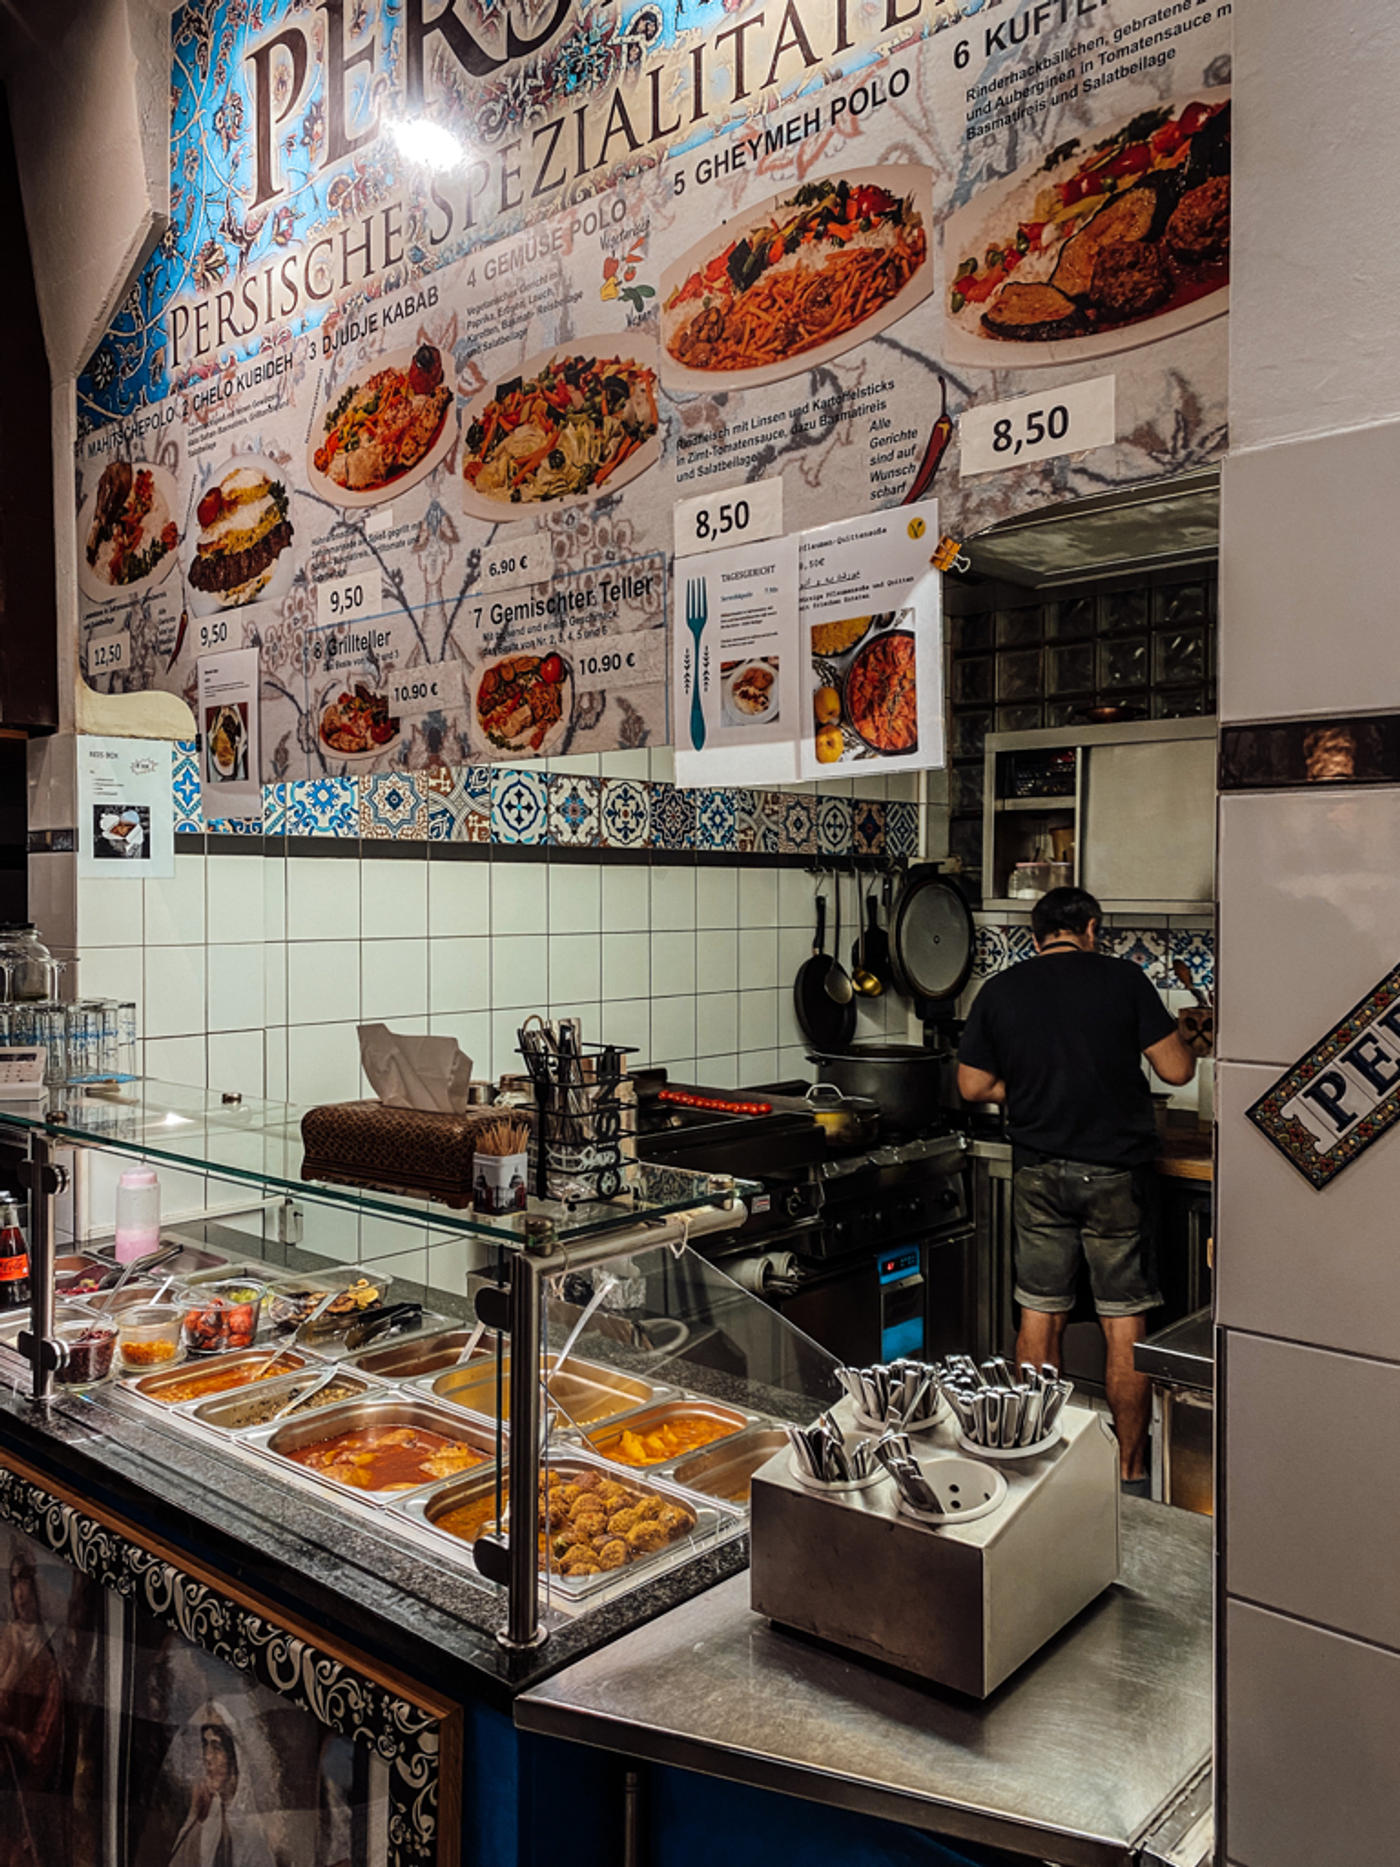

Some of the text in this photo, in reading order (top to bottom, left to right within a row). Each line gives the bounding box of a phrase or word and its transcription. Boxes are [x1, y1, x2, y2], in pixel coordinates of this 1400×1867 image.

[952, 40, 971, 70] 6
[966, 1, 1192, 102] Rinderhackbällchen, gebratene
[966, 101, 992, 121] und
[995, 68, 1076, 110] Auberginen
[1080, 60, 1094, 76] in
[1098, 12, 1212, 66] Tomatensauce
[966, 47, 1176, 140] Basmatireis und Salatbeilage
[673, 67, 910, 196] 5 GHEYMEH POLO
[466, 268, 478, 288] 4
[570, 198, 627, 243] POLO
[170, 201, 404, 369] PERSISCHE
[308, 285, 439, 360] 3 DJUDJE KABAB
[181, 352, 294, 417] 2 CHELO KUBIDEH
[732, 420, 749, 435] mit
[751, 411, 786, 430] Linsen
[789, 403, 809, 419] und
[812, 380, 896, 412] Kartoffelsticks
[676, 455, 686, 466] in
[791, 420, 817, 436] dazu
[819, 399, 887, 427] Basmatireis
[869, 416, 892, 433] Alle
[869, 428, 918, 450] Gerichte
[992, 404, 1069, 456] 8,50
[676, 453, 757, 483] und Salatbeilage
[869, 444, 918, 467] sind auf
[870, 463, 916, 483] Wunsch
[870, 480, 908, 501] scharf
[695, 499, 750, 542] 8,50
[488, 555, 529, 577] 6.90 €
[330, 584, 364, 615] 9,50
[473, 575, 654, 629] 7 Gemischter Teller
[199, 621, 228, 648] 9,50
[313, 629, 391, 660] 8 Grillteller
[94, 643, 122, 667] 12,50
[578, 651, 636, 677] 10.90 €
[394, 682, 439, 702] 10.90 €
